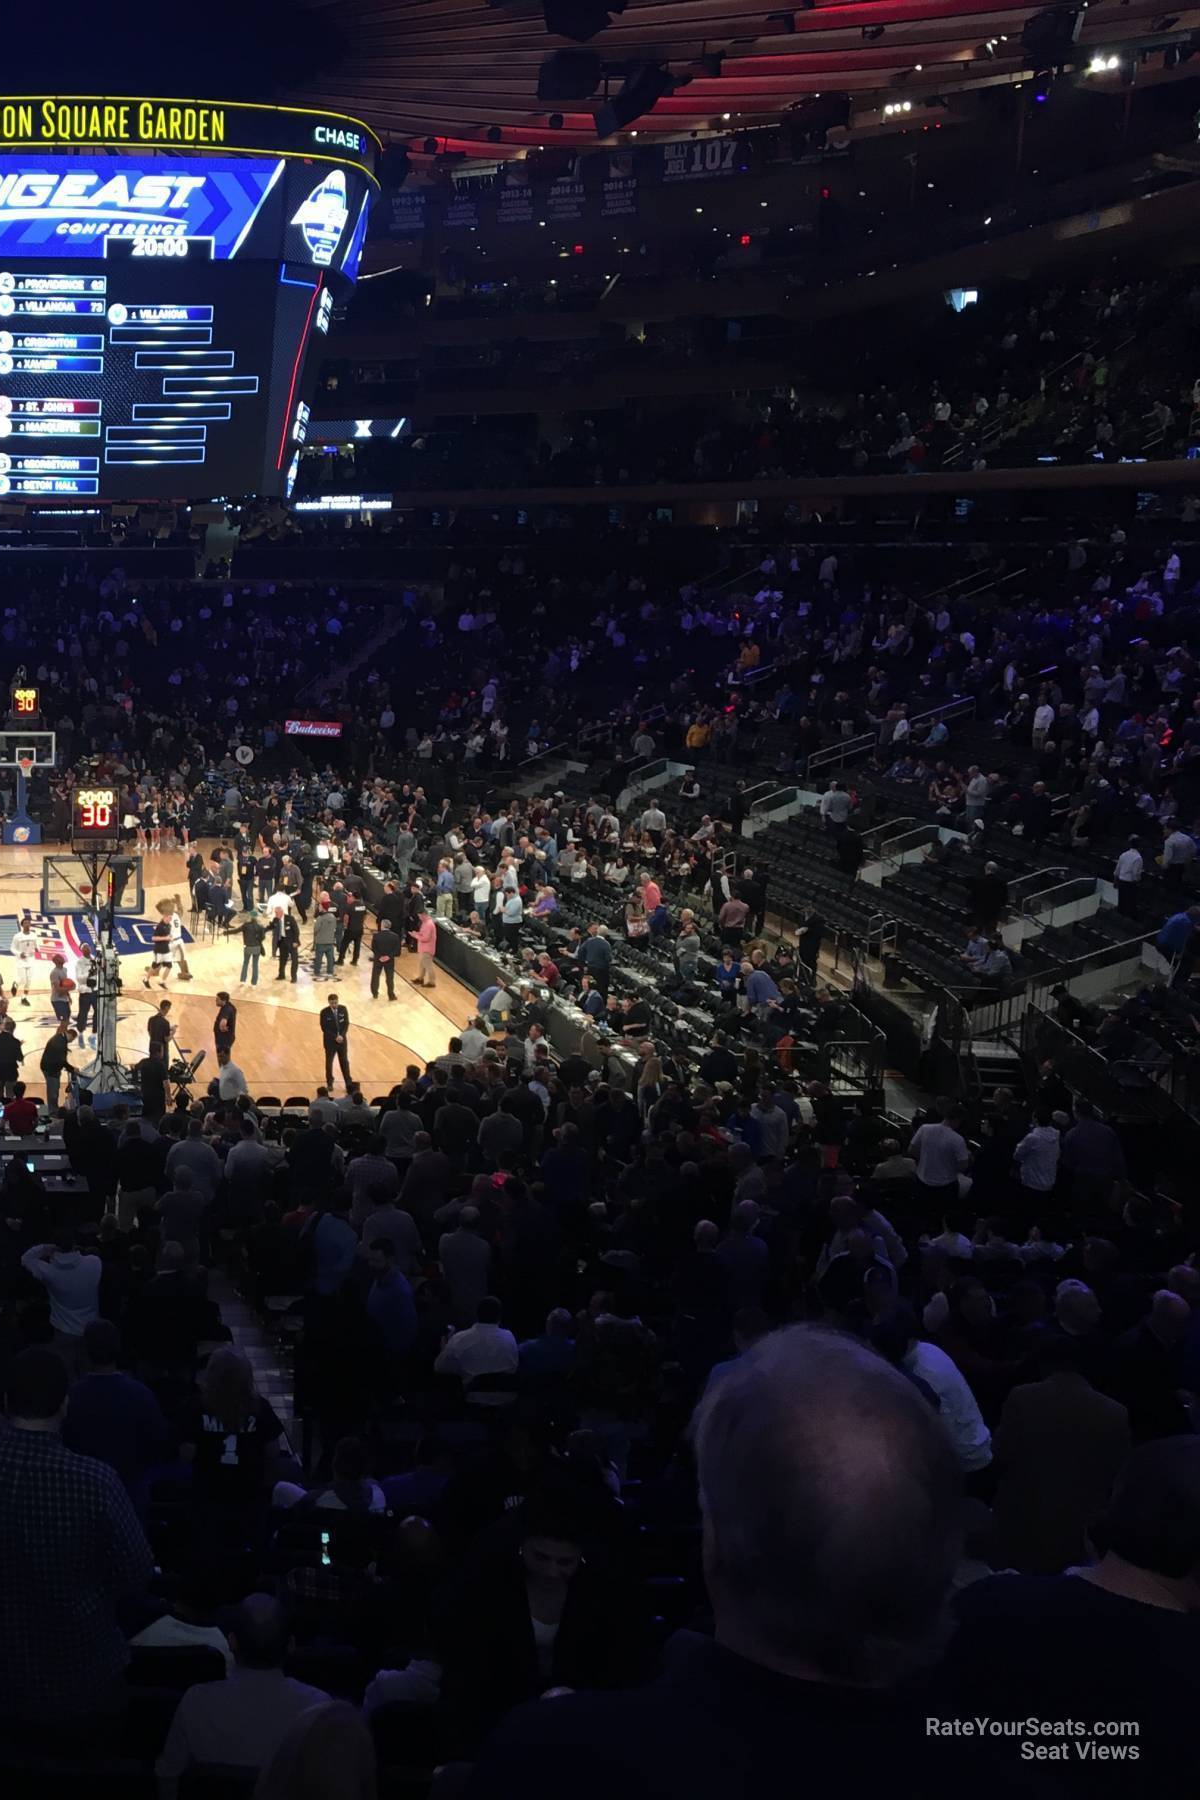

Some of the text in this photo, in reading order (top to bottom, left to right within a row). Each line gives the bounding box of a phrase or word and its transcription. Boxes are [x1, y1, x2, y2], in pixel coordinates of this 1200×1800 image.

[41, 101, 130, 139] SQUARE
[138, 103, 225, 141] GARDEN
[315, 126, 360, 150] CHASE
[690, 140, 738, 172] 107
[56, 223, 188, 236] CONFERENCE
[131, 238, 188, 257] 20:00
[25, 279, 85, 291] PROVIDENCE
[25, 301, 76, 312] VILLANOVA
[91, 302, 103, 313] 73
[140, 309, 189, 320] VILLANOVA
[24, 337, 78, 348] CREIGHTON
[23, 359, 58, 370] XAVIER
[25, 422, 81, 434] MARQUETTE
[23, 459, 80, 470] GEORGETOWN
[23, 480, 53, 491] SETON
[55, 480, 79, 491] HALL
[17, 698, 34, 711] 30
[286, 721, 341, 736] Budweiser
[78, 791, 113, 805] 20:00
[83, 804, 110, 826] 30
[219, 1432, 239, 1465] 1
